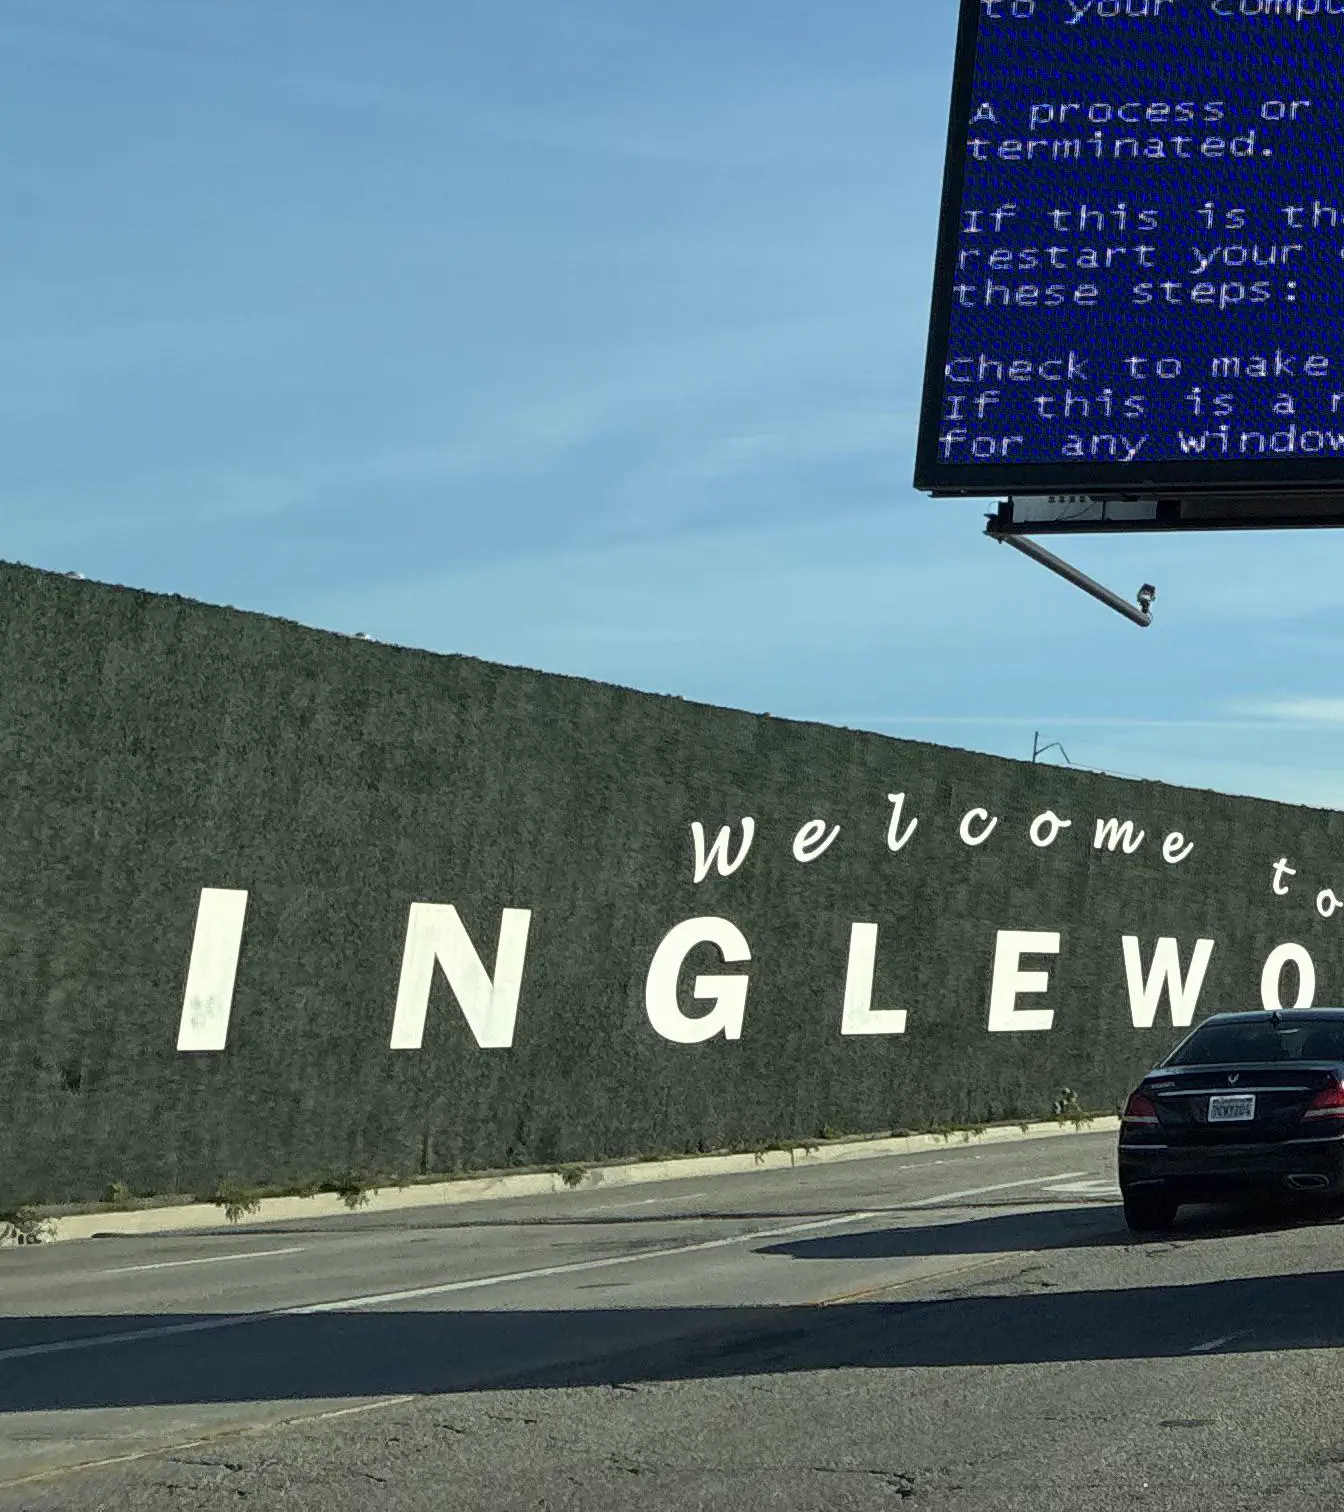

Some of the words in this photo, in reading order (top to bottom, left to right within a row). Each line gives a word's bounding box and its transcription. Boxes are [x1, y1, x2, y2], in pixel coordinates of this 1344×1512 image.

[968, 100, 998, 125] A
[1030, 102, 1223, 129] process
[1261, 100, 1310, 120] or
[967, 126, 1272, 160] terminated.
[964, 204, 1015, 233] If
[1052, 203, 1156, 231] this
[1198, 201, 1246, 230] is
[959, 245, 1154, 269] restart
[1192, 244, 1302, 274] your
[953, 281, 1098, 305] these
[1133, 271, 1296, 309] steps:
[1125, 356, 1181, 378] to
[1211, 351, 1329, 377] make
[946, 390, 997, 420] If
[1035, 388, 1144, 418] this
[1187, 387, 1232, 416] is
[1273, 393, 1295, 414] a
[939, 429, 1023, 457] for
[1062, 433, 1148, 462] any
[690, 791, 1194, 885] Welcome
[1272, 857, 1344, 918] to
